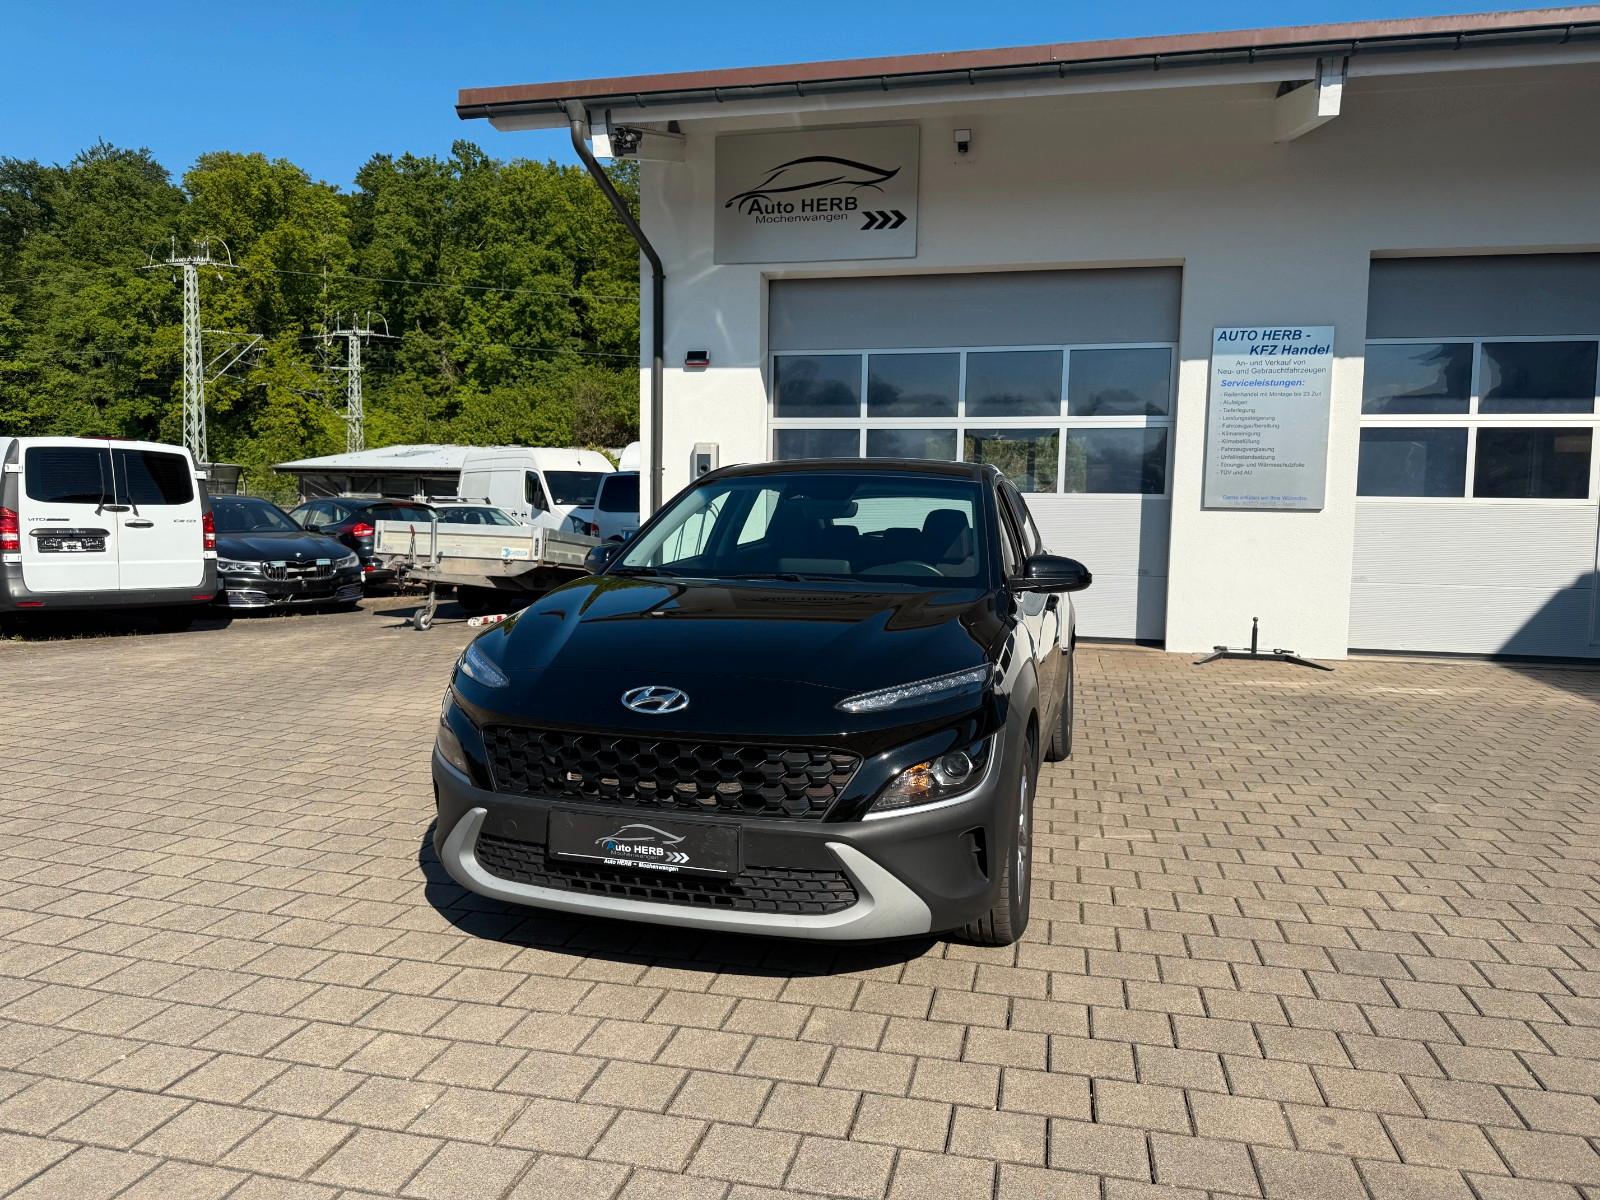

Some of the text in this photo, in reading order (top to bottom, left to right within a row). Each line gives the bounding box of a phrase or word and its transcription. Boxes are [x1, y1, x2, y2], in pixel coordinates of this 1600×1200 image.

[748, 197, 858, 215] Auto HERB
[755, 213, 848, 224] Mochenwangen
[1217, 330, 1258, 342] AUTO
[1261, 329, 1302, 341] HERB
[1249, 344, 1330, 355] KFZ Handel
[1220, 379, 1305, 388] Serviceleistungen:
[607, 841, 664, 856] Auto HERB
